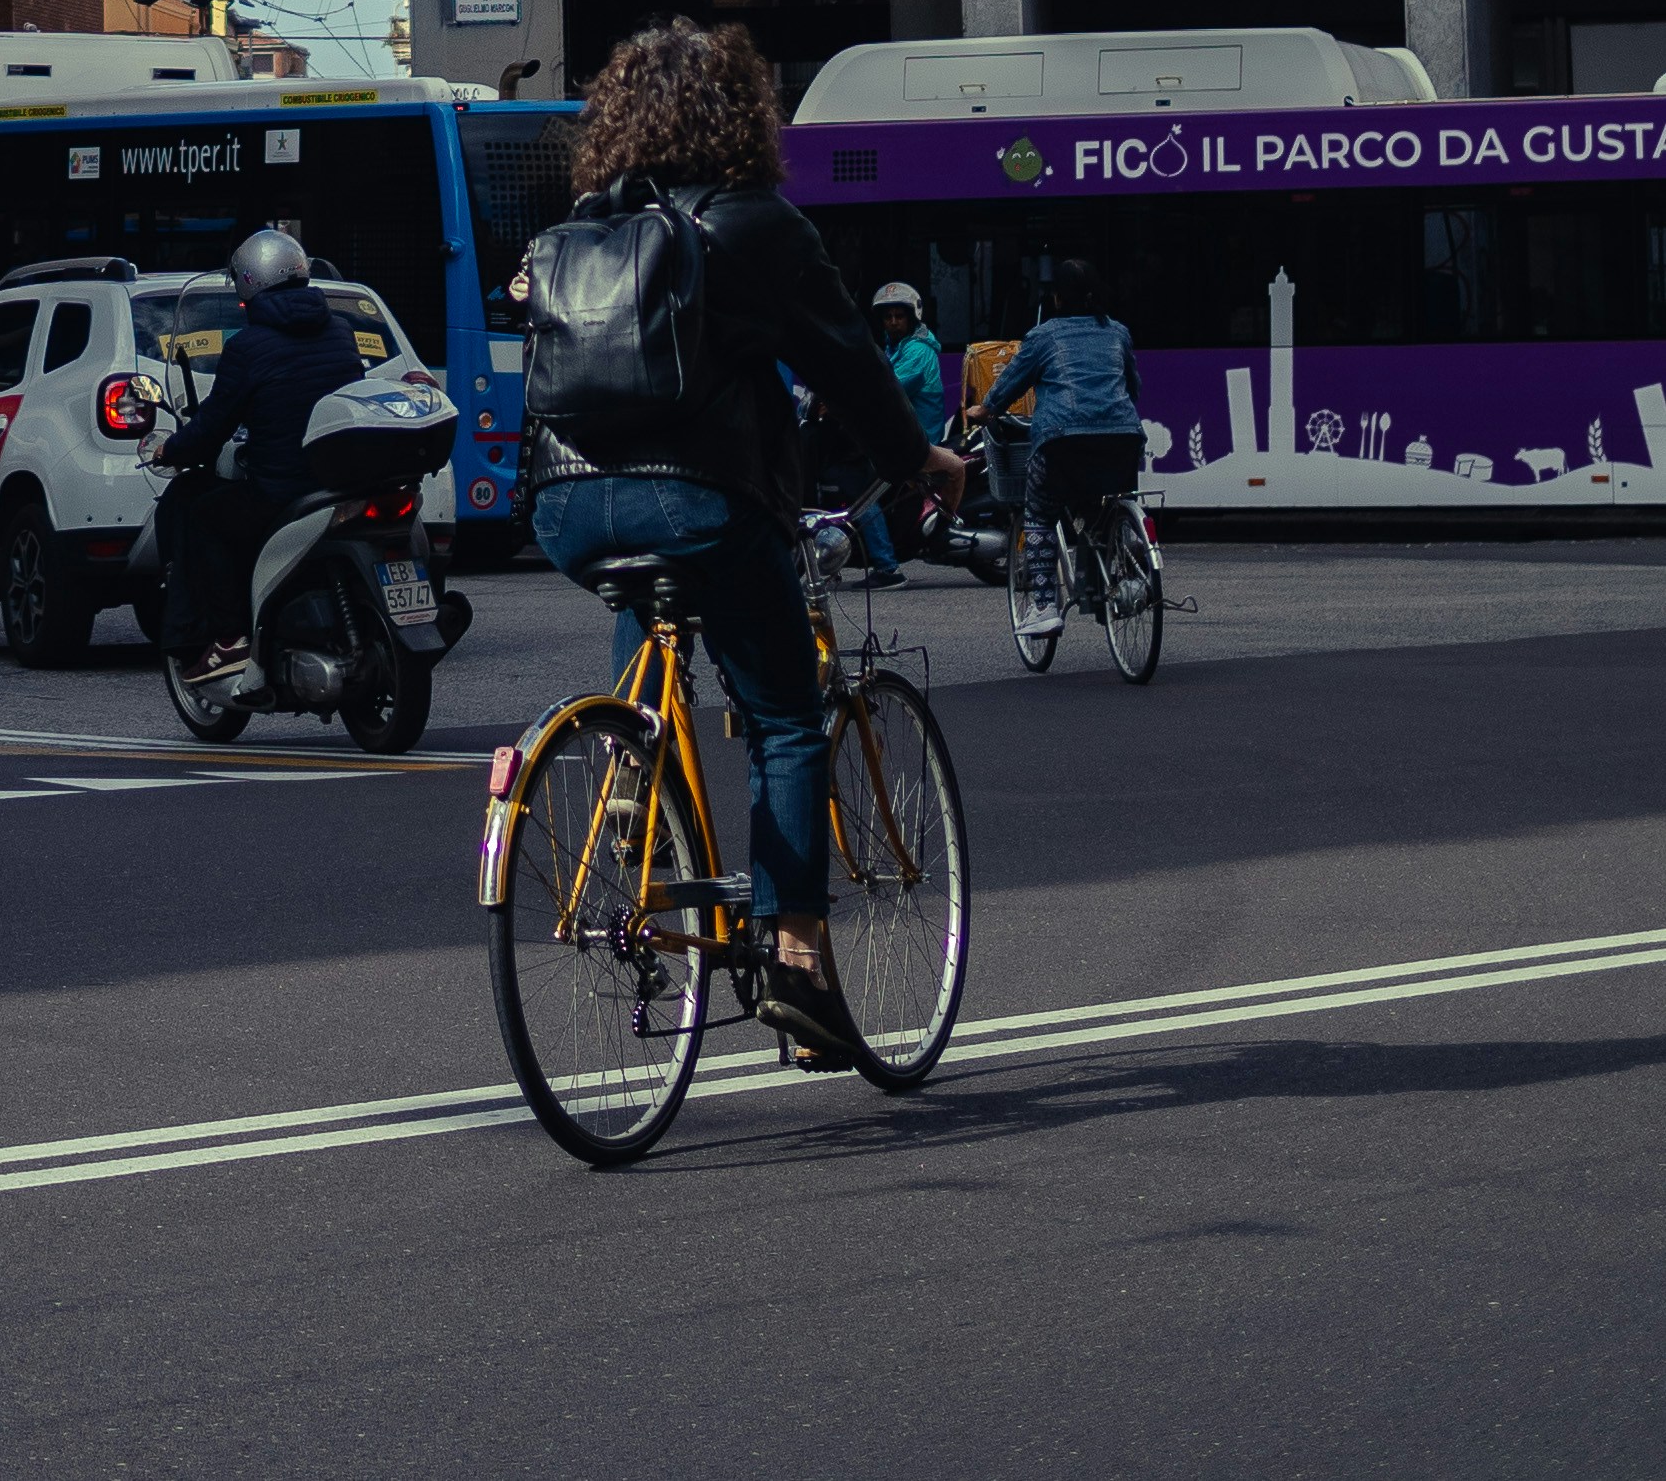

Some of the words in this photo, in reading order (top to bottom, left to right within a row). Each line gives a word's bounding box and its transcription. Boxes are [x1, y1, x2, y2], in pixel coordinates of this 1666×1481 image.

[283, 94, 332, 105] COMBUSTIBILE
[333, 91, 375, 102] CRIOGENICO
[121, 133, 241, 184] www.tper.it
[1202, 136, 1242, 173] IL
[1255, 130, 1422, 171] PARCO
[1438, 127, 1510, 167] DA
[476, 487, 491, 501] 80
[388, 562, 409, 582] EB
